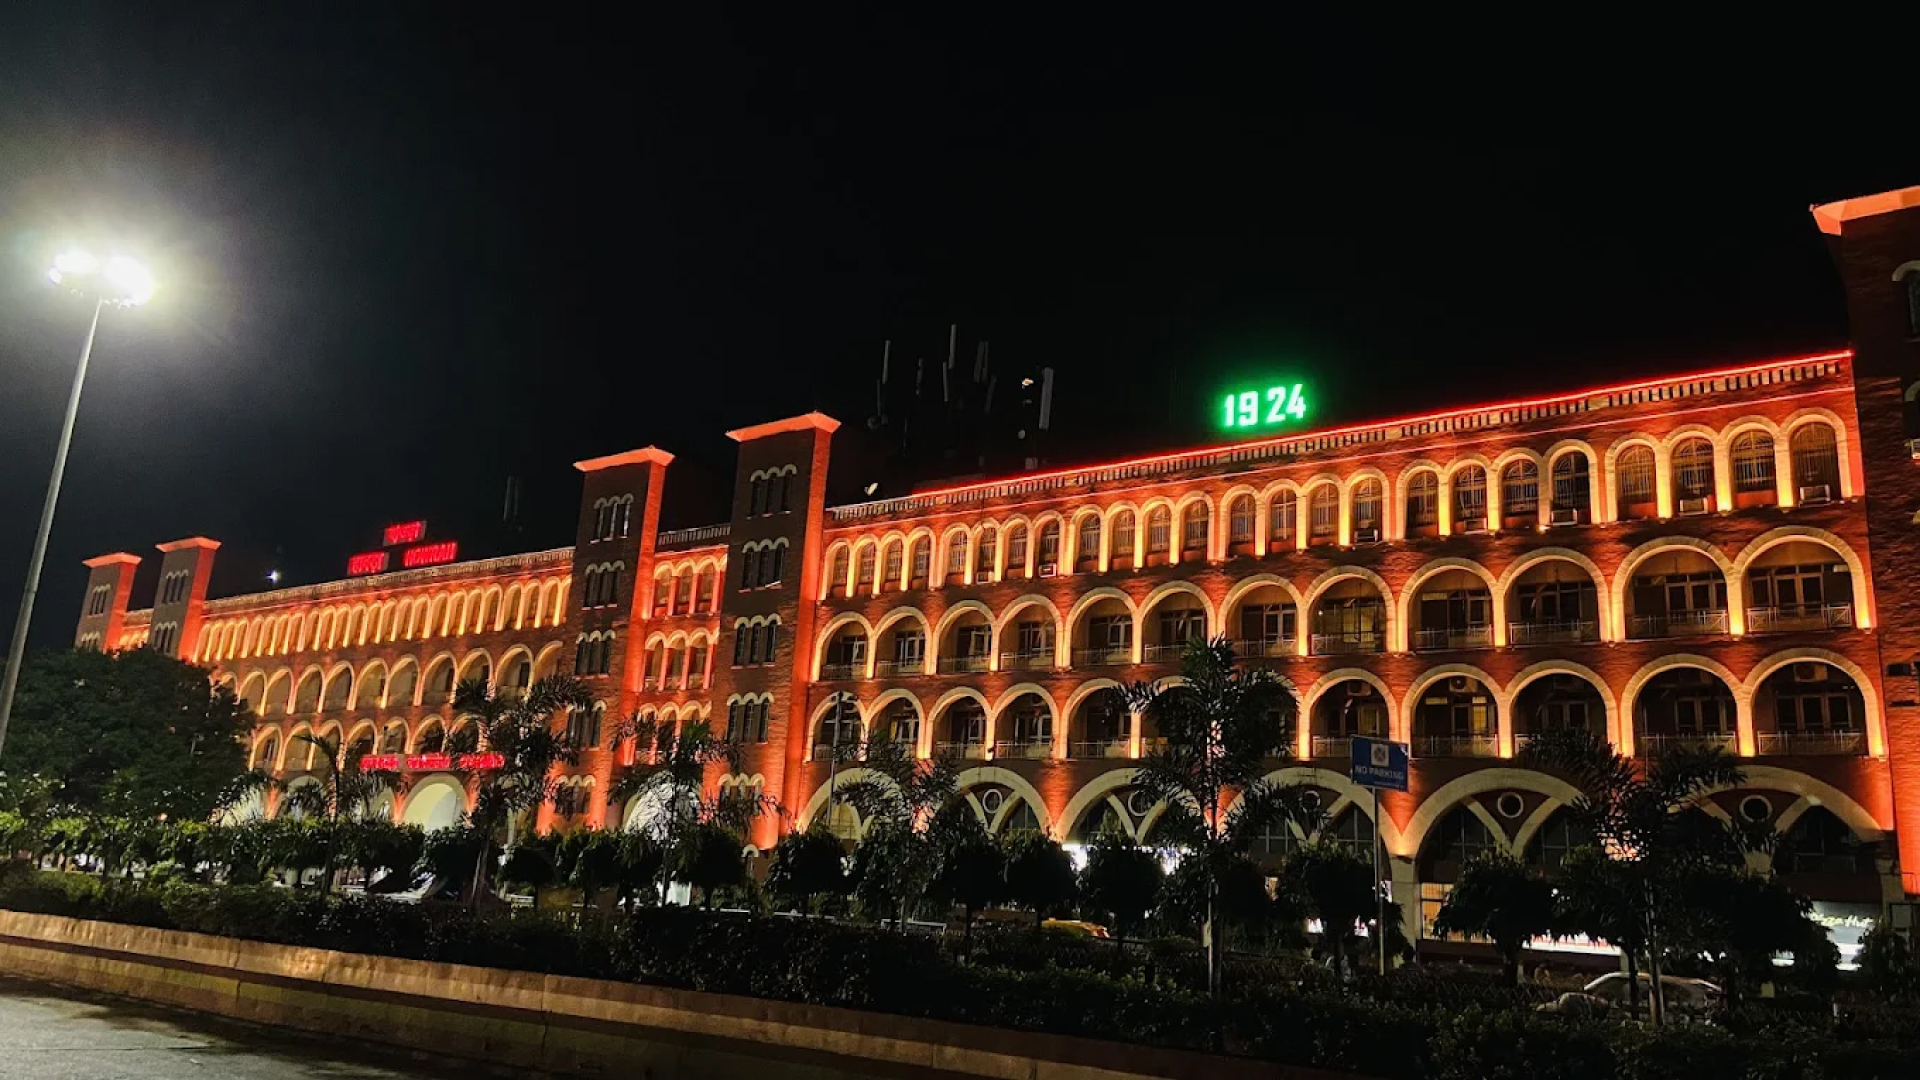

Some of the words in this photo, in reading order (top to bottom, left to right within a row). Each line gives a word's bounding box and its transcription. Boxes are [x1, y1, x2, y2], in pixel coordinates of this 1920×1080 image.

[403, 542, 456, 567] HOWRAH
[1354, 764, 1368, 775] NO
[1369, 767, 1404, 780] PARKING
